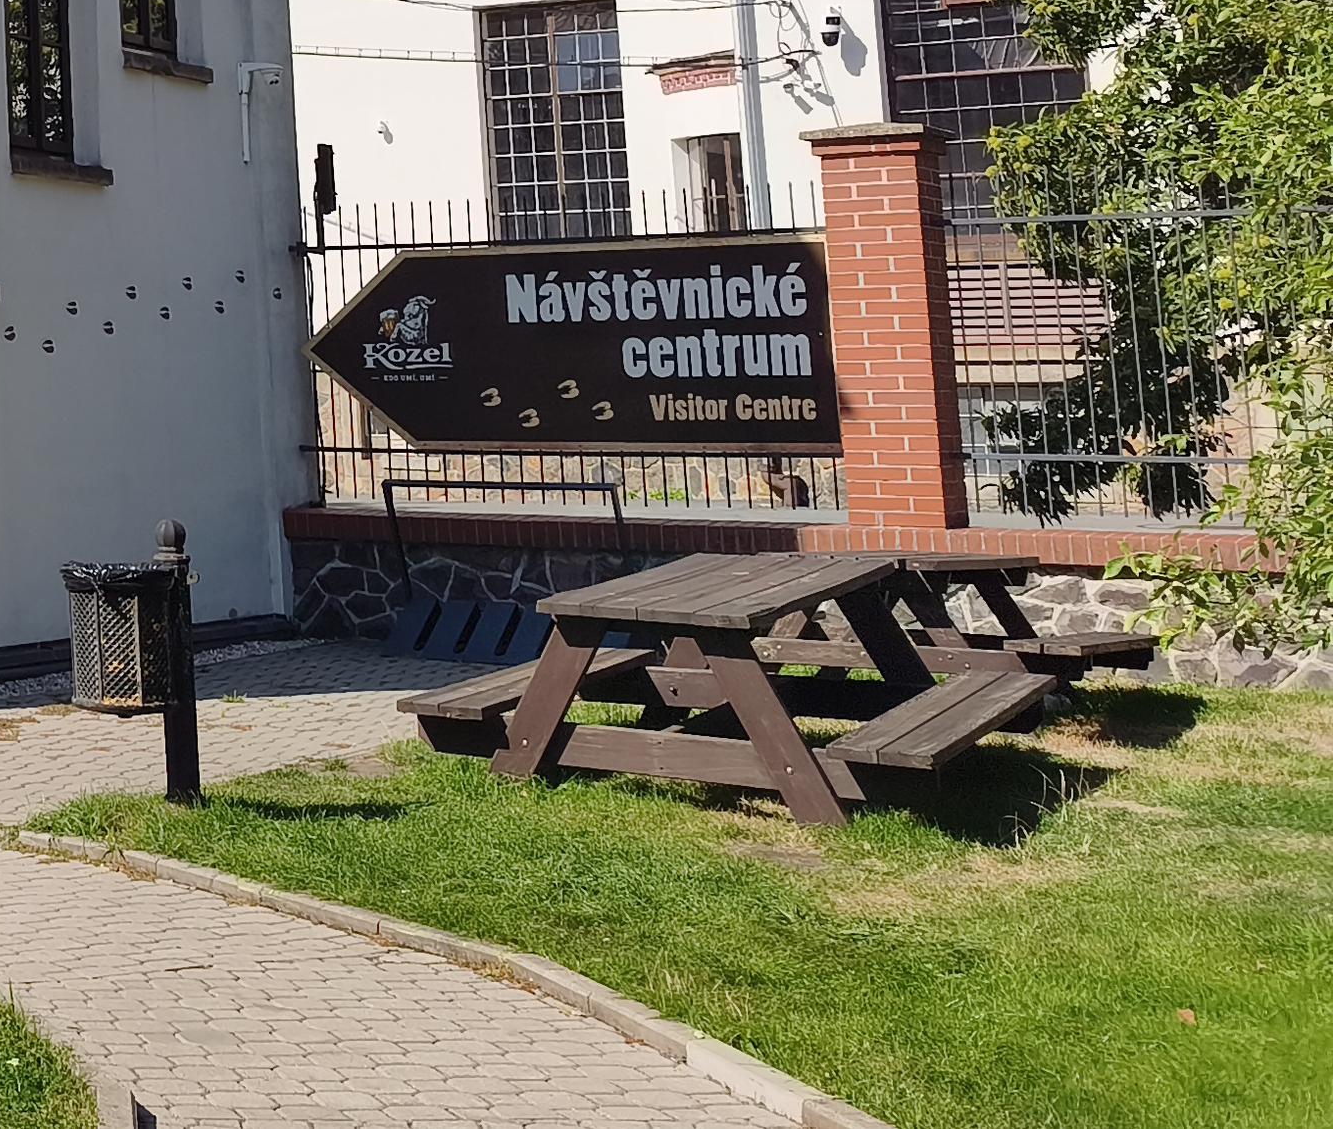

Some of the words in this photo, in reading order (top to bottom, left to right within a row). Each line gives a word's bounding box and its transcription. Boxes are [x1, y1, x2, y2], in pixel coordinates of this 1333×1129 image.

[505, 262, 808, 324] Návštěvnické
[363, 342, 454, 370] Kozel
[621, 329, 813, 379] centrum
[649, 392, 728, 423] Visitor
[735, 391, 818, 422] Centre
